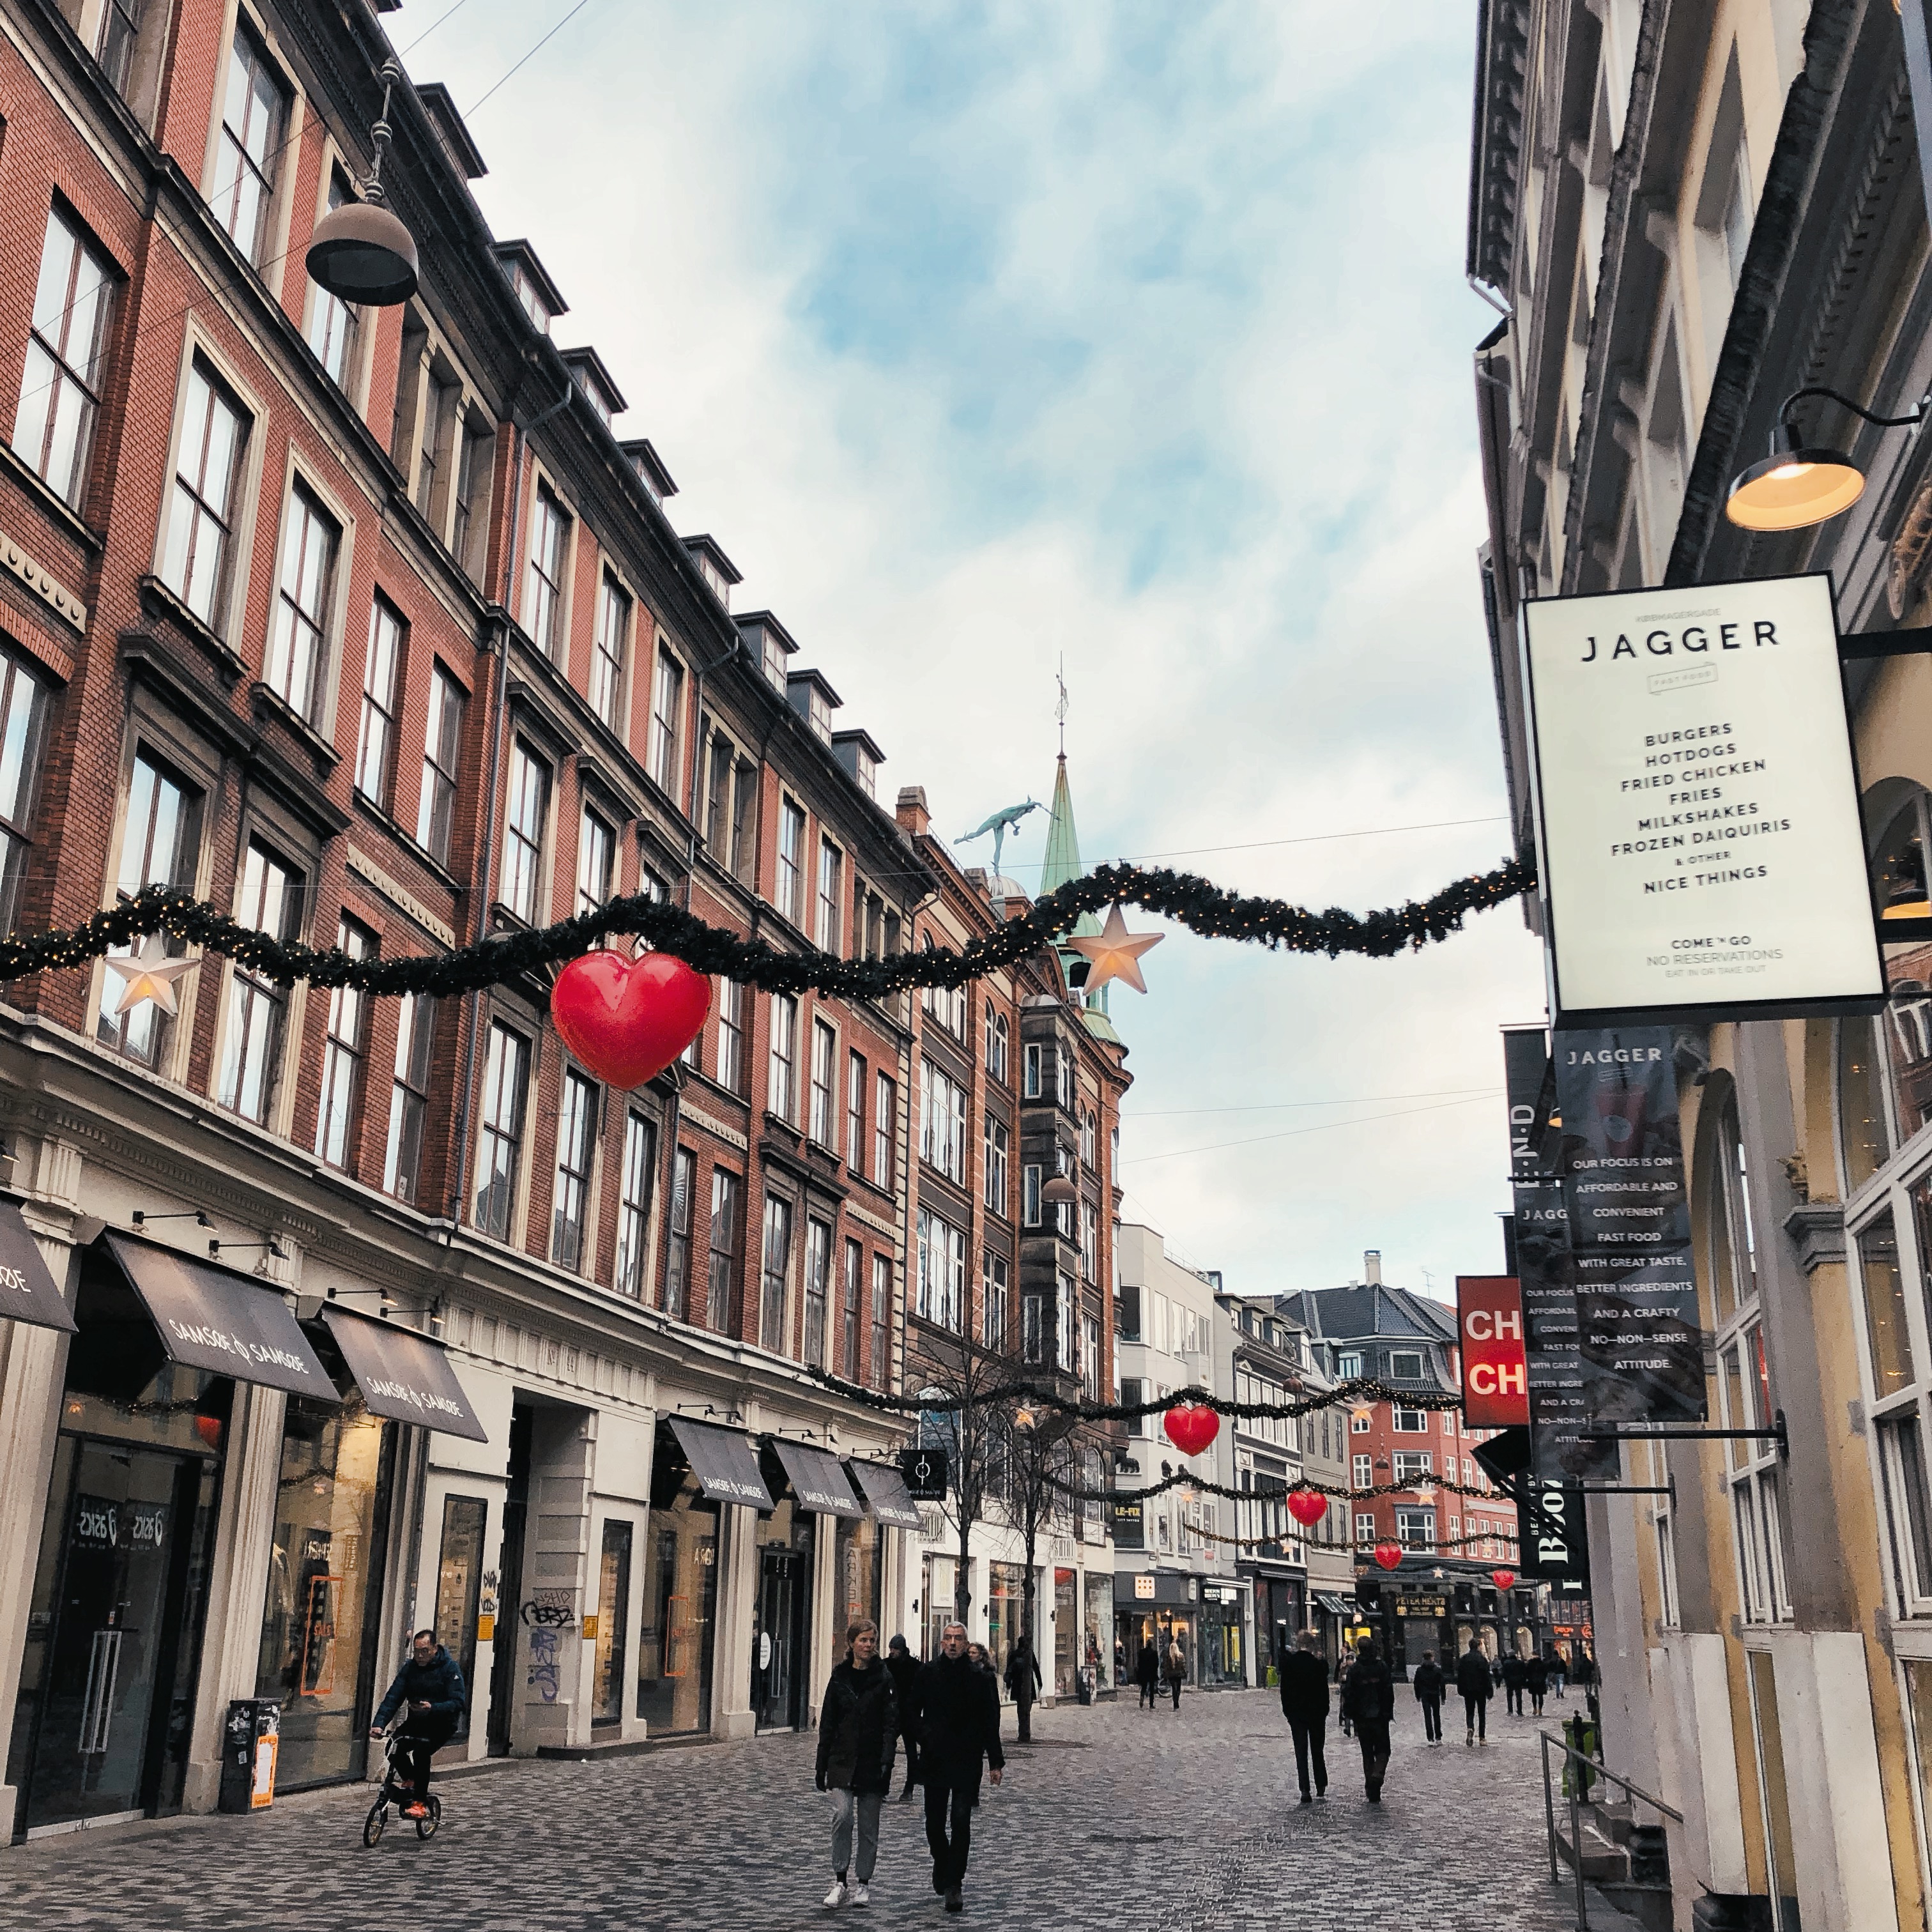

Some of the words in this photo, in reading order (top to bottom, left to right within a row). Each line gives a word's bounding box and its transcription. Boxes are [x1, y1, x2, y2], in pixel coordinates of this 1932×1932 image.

[1581, 620, 1780, 662] JAGGER
[1644, 723, 1733, 747] BURGERS
[1645, 743, 1736, 767] HOTDOGS
[1621, 773, 1674, 792] FRIED
[1682, 758, 1766, 783] CHICKEN
[1669, 787, 1722, 806] FRIES
[1637, 802, 1759, 831] MILKSHAKES
[1611, 832, 1685, 857] FROZEN
[1692, 818, 1791, 844] DAIQUIRIS
[1675, 857, 1682, 866] &
[1687, 850, 1731, 864] OTHER
[1643, 876, 1689, 894] NICE
[1696, 865, 1768, 886] THINGS
[1671, 938, 1714, 949] COME
[1729, 936, 1751, 946] GO
[1646, 956, 1669, 966] NO
[1673, 949, 1783, 964] RESERVATIONS
[1567, 1048, 1662, 1065] JAGGER
[1573, 1160, 1598, 1169] OUR
[1601, 1158, 1639, 1167] FOCUS
[1641, 1158, 1652, 1166] IS
[1653, 1158, 1673, 1166] ON
[1575, 1183, 1649, 1193] AFFORDABLE
[1652, 1182, 1678, 1191] AND
[1593, 1208, 1664, 1216] CONVENIENT
[1598, 1233, 1625, 1241] FAST
[1628, 1233, 1661, 1241] FOOD
[1578, 1259, 1607, 1268] WITH
[1609, 1258, 1645, 1267] GREAT
[1649, 1257, 1687, 1266] TASTE.
[0, 1266, 31, 1292] ØE
[1576, 1284, 1616, 1293] BETTER
[1619, 1282, 1692, 1292] INGREDIENTS
[1593, 1310, 1618, 1318] AND
[1621, 1309, 1631, 1317] A
[1634, 1308, 1680, 1317] CRAFTY
[169, 1319, 236, 1354] SAMSØE
[249, 1344, 309, 1374] SAMSØE
[366, 1377, 412, 1404] SAMSØE
[1116, 1507, 1140, 1516] LE-FIX
